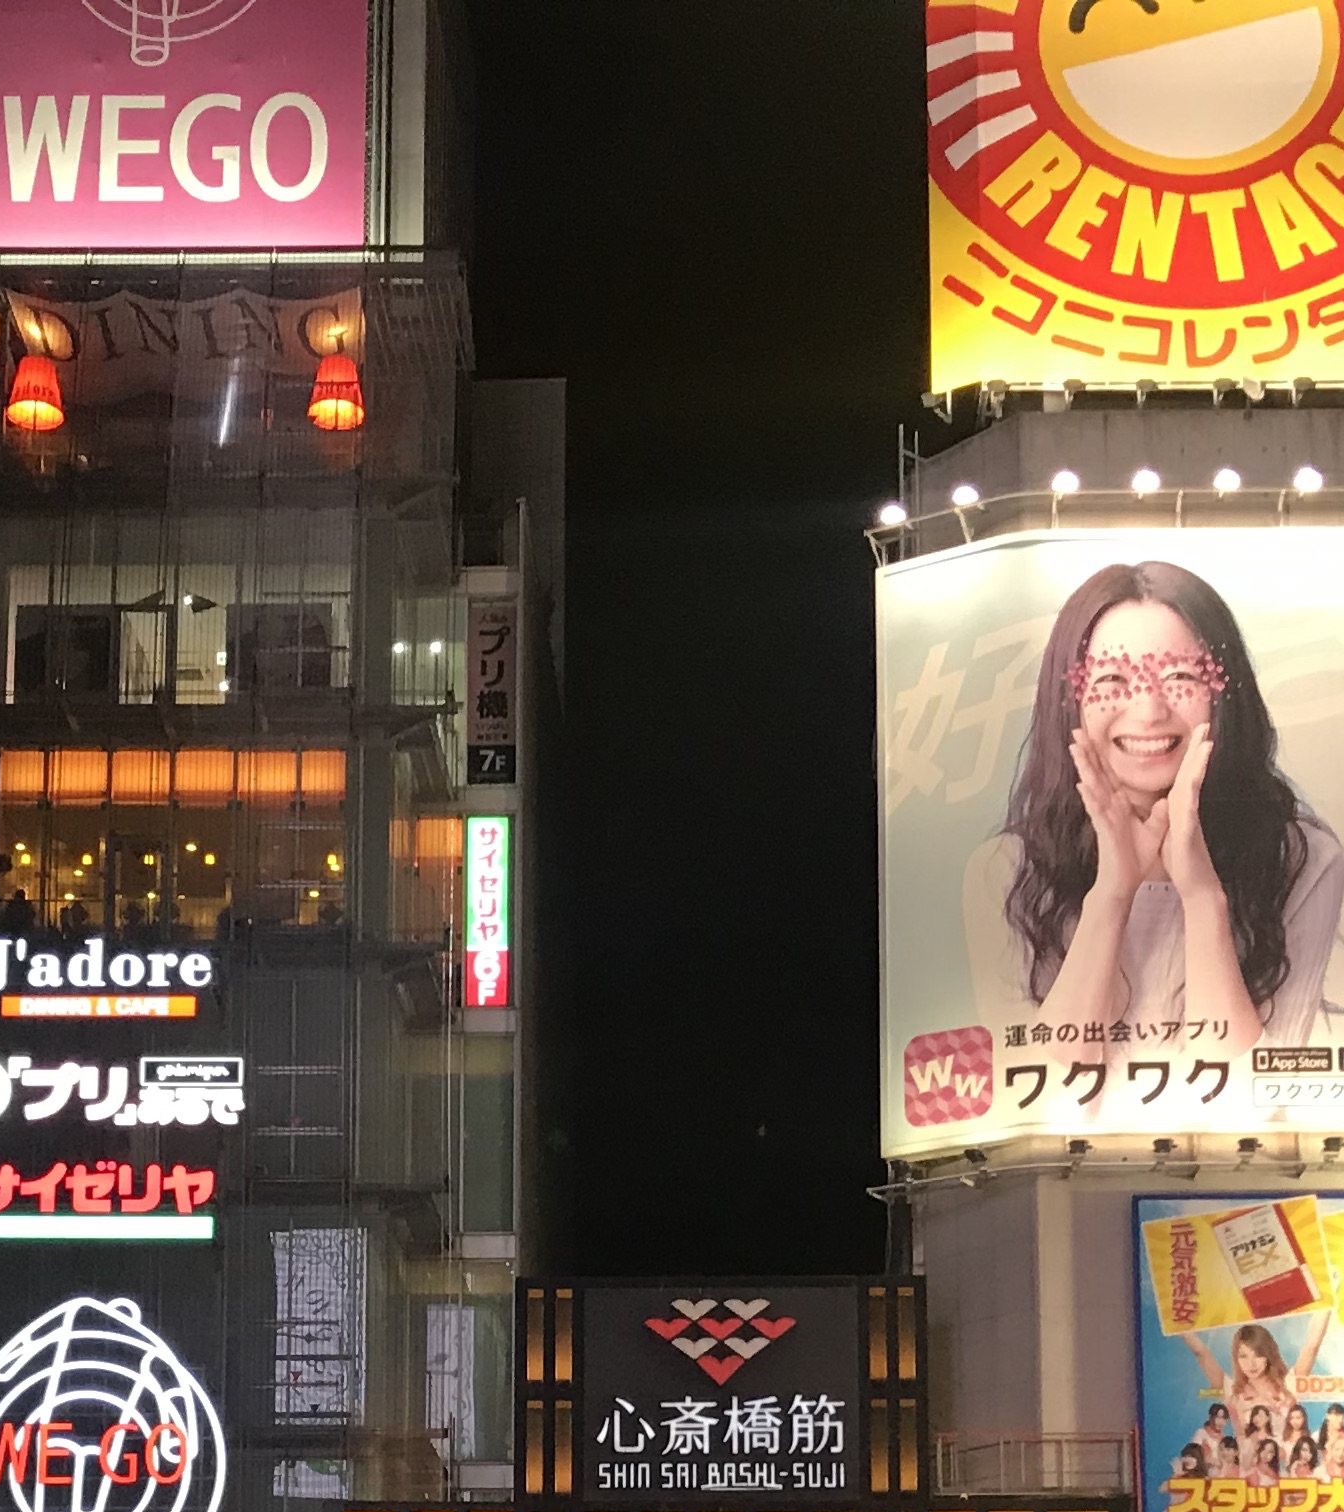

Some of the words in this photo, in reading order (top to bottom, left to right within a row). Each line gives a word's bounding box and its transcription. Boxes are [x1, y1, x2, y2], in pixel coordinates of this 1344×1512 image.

[3, 92, 329, 203] WEGO
[479, 749, 508, 773] 7F
[473, 953, 501, 1006] 6F
[1004, 1018, 1231, 1048] 運命の出会いアプリ
[1004, 1060, 1231, 1110] ワクワク
[1271, 1057, 1297, 1071] App
[1299, 1056, 1329, 1069] Store
[1170, 1222, 1198, 1325] 元気激安
[596, 1393, 846, 1456] 心斎橋筋
[598, 1461, 650, 1489] SHIN
[660, 1461, 698, 1490] SAI
